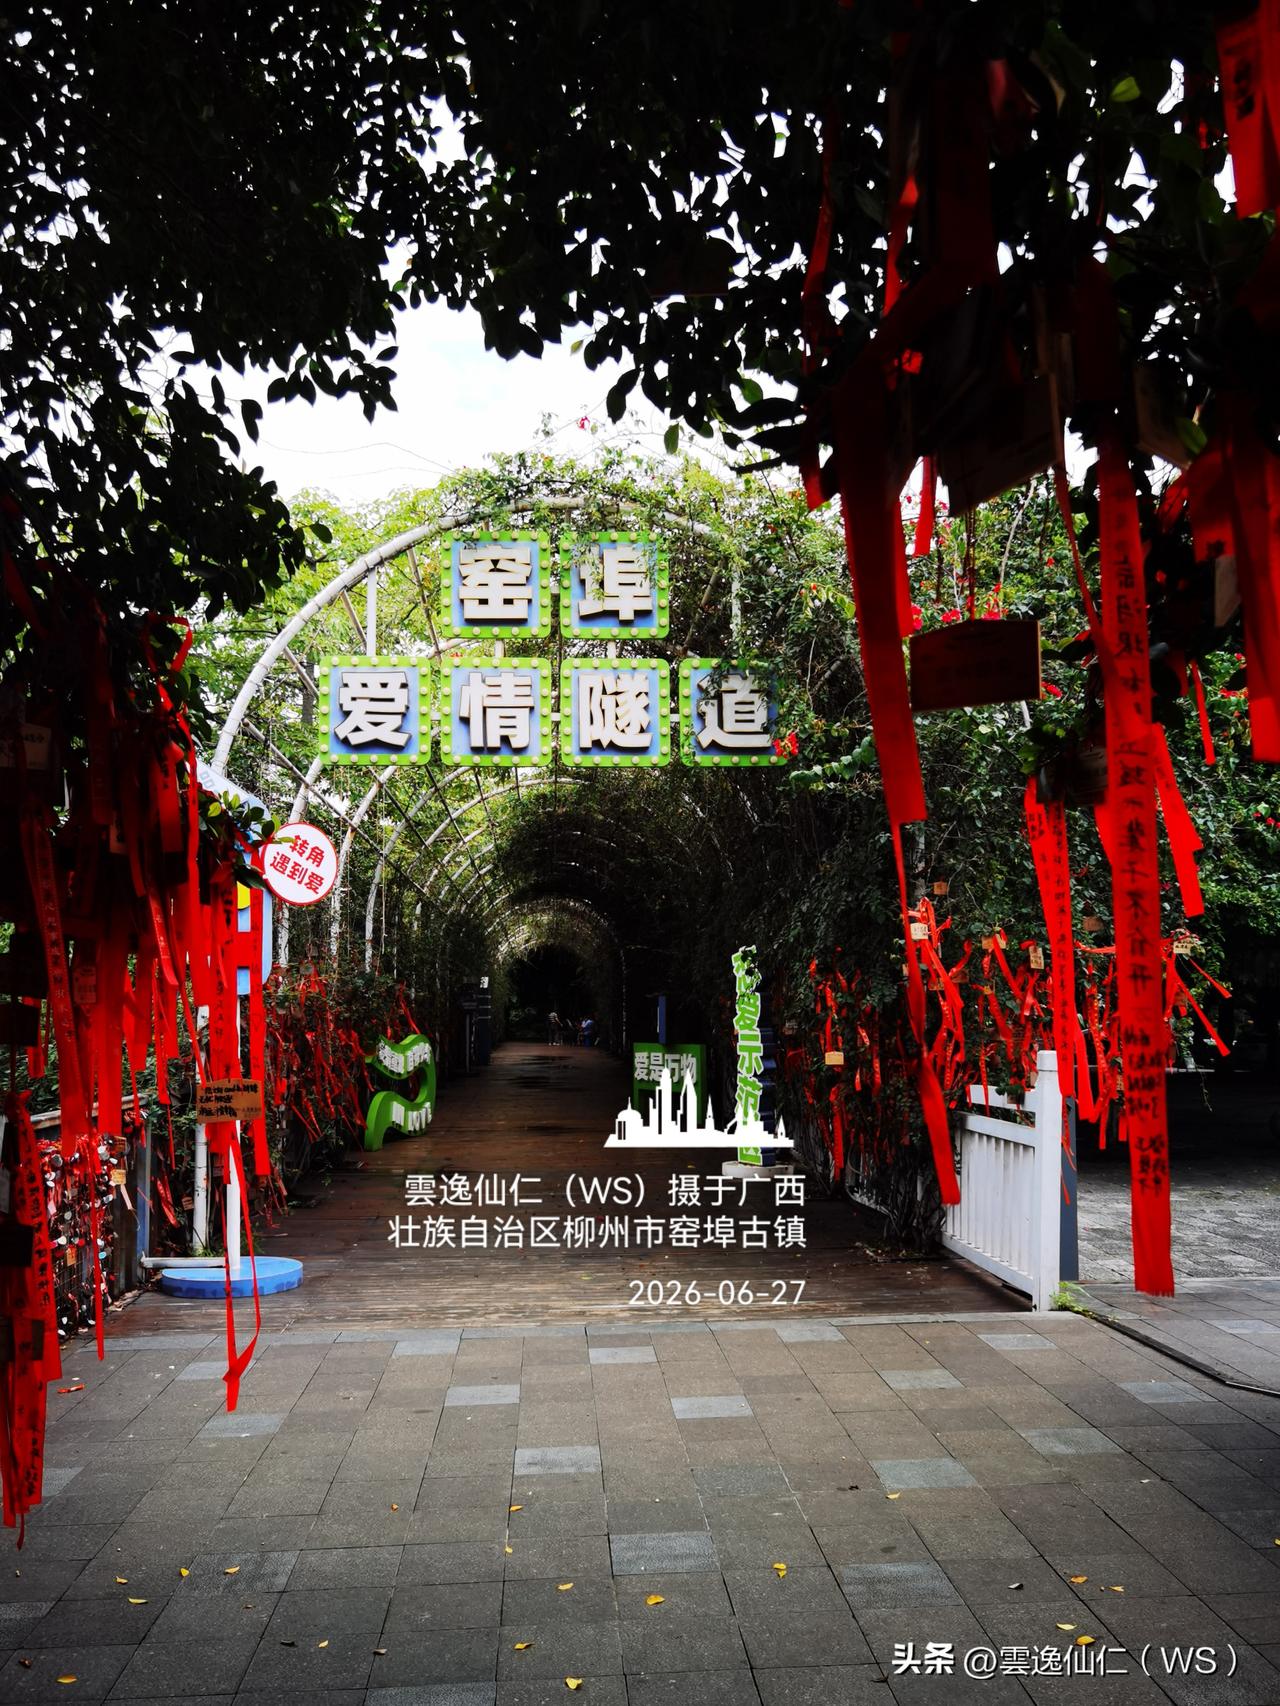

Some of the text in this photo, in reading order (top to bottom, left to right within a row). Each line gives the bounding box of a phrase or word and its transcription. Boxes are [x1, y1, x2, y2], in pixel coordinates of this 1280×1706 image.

[458, 545, 655, 621] 窑埠
[334, 671, 772, 749] 爱情隧道
[289, 835, 325, 868] 转角
[269, 852, 325, 895] 遇到爱
[634, 1052, 697, 1084] 爱是万物
